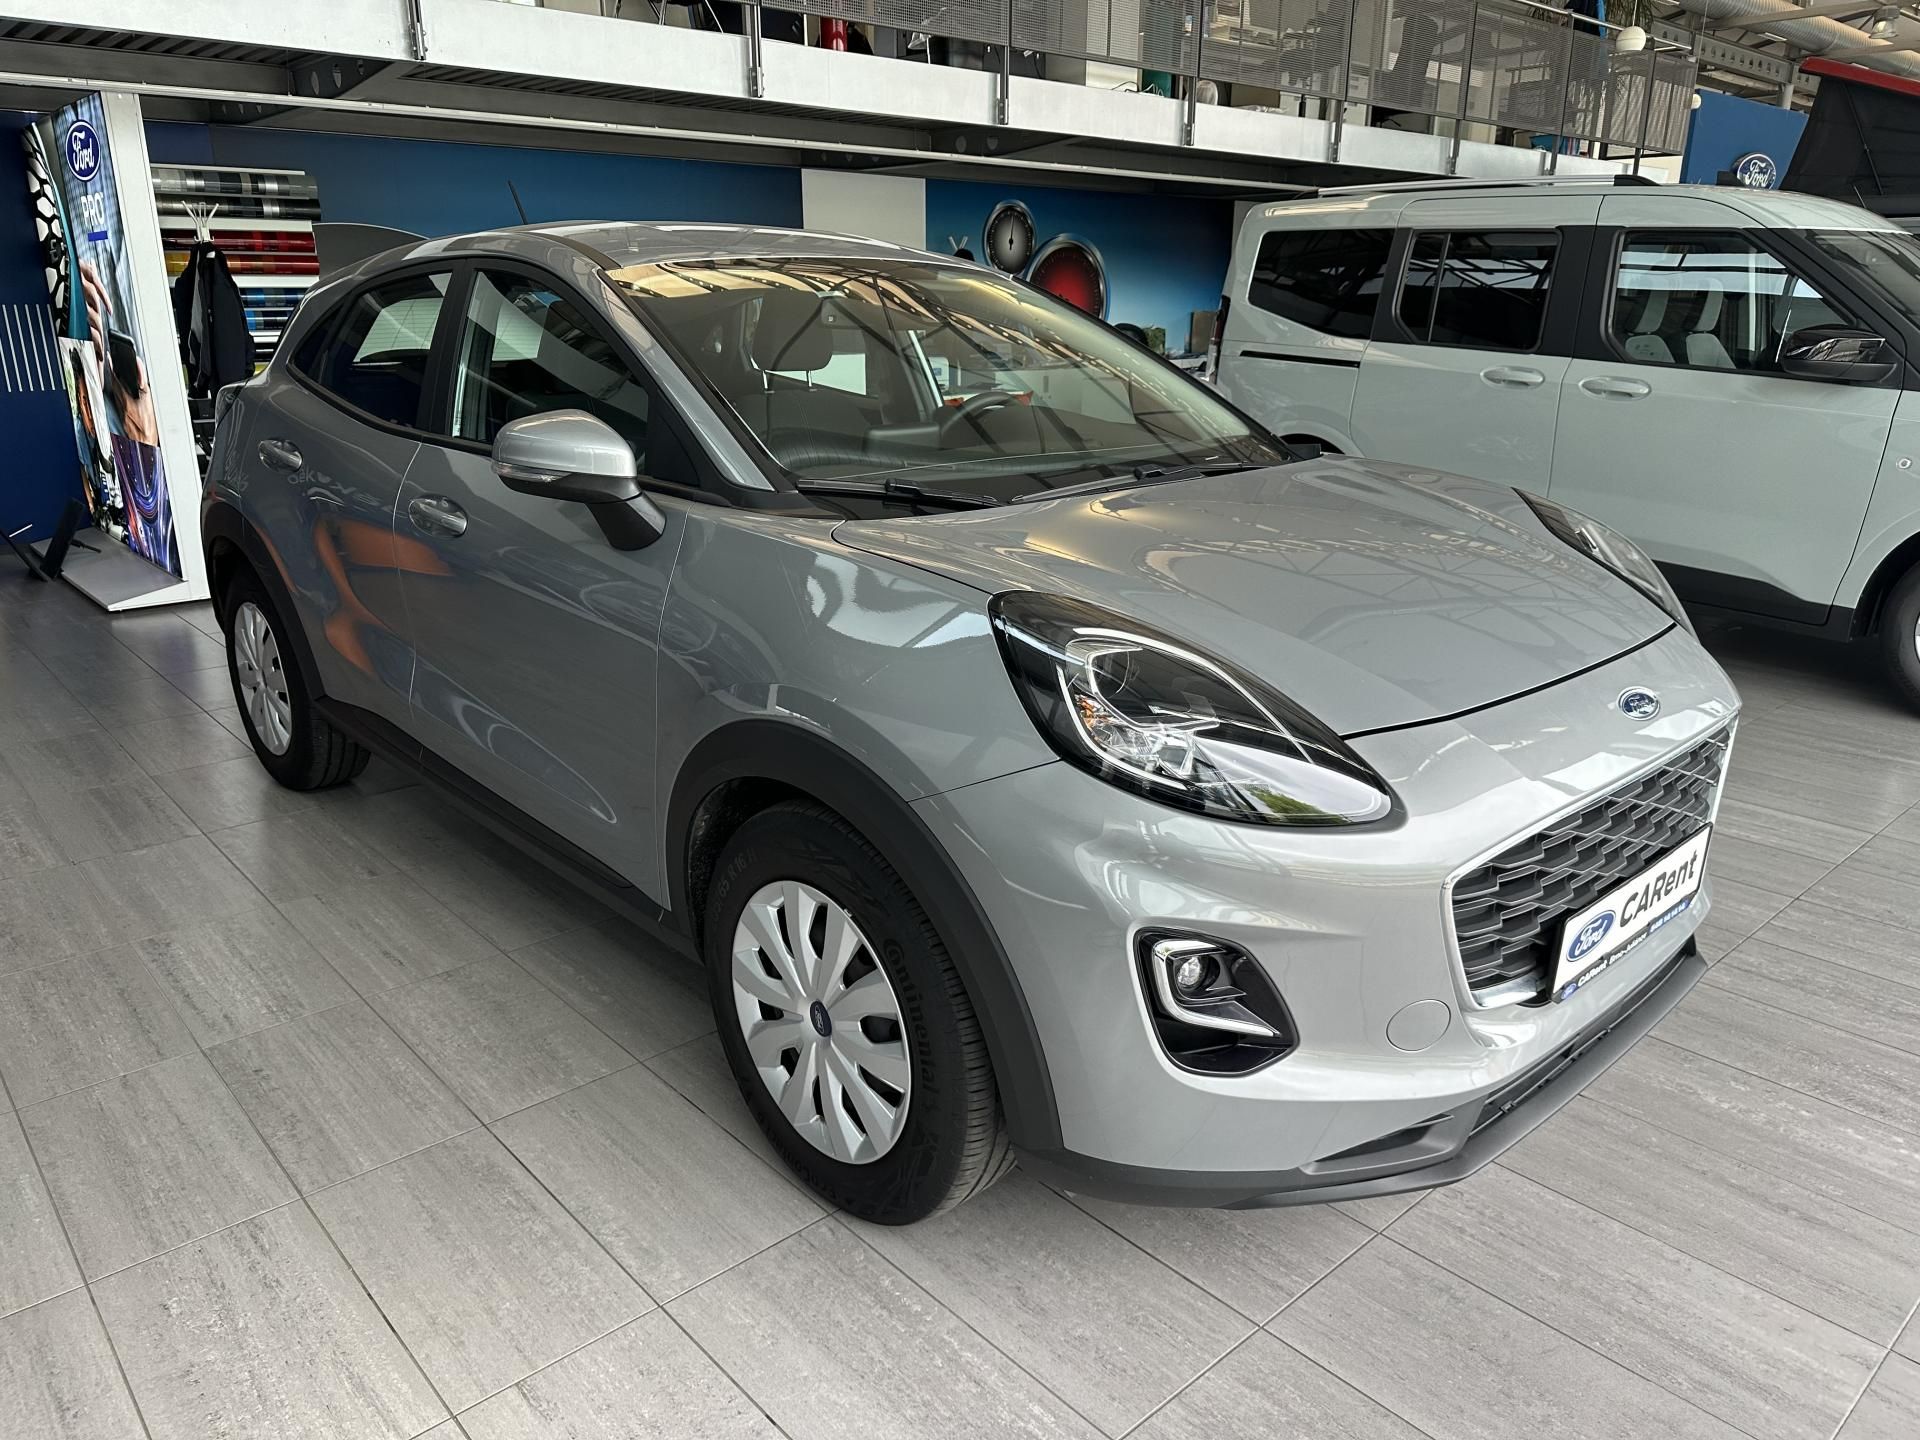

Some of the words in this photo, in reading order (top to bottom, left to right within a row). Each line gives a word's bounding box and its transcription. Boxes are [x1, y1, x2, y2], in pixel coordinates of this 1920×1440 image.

[72, 131, 95, 171] Ford
[1744, 160, 1771, 187] Ford
[81, 193, 105, 227] PRO
[1575, 917, 1608, 956] Ford
[1619, 849, 1697, 928] CARent
